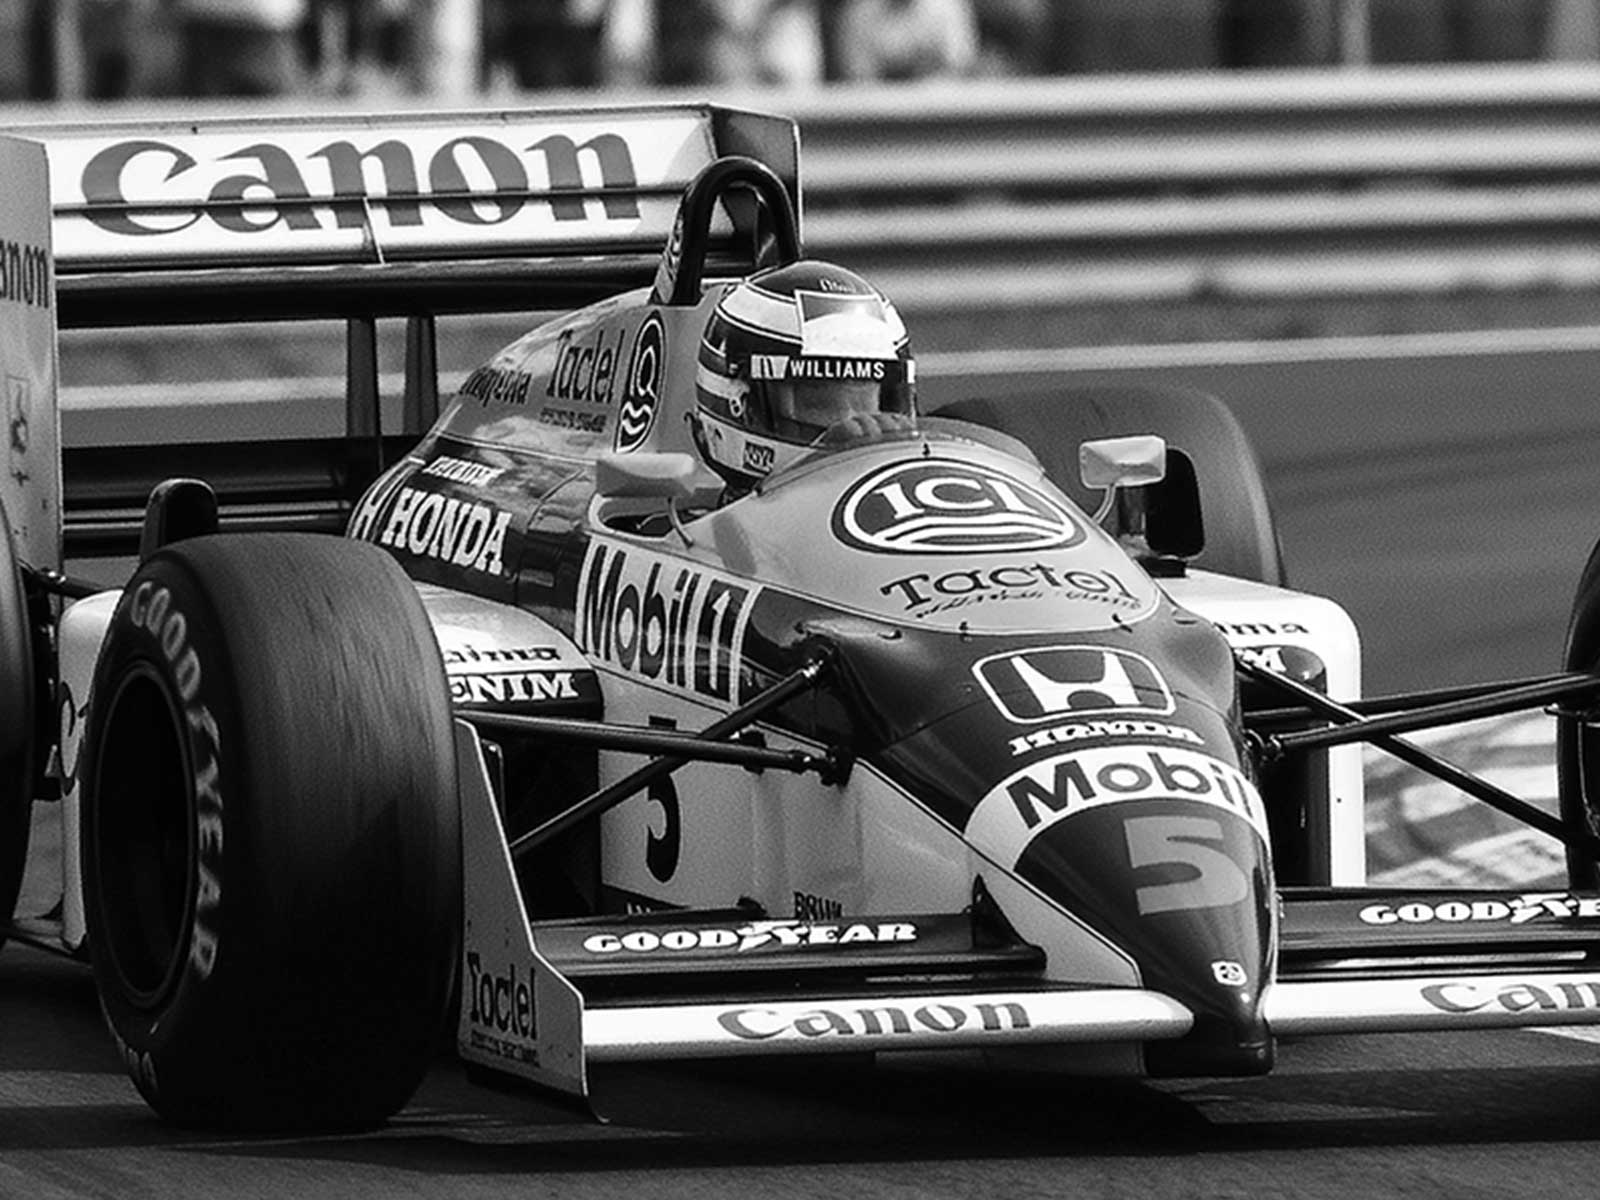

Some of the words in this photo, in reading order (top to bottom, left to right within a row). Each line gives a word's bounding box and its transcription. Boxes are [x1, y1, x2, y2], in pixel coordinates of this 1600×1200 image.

[81, 132, 642, 236] Canon
[790, 360, 886, 380] WILLIAMS
[873, 476, 1041, 520] ICI
[381, 487, 513, 576] HONDA
[880, 563, 1137, 611] Tactel
[583, 544, 701, 689] Mobil
[1008, 720, 1206, 757] HONDA
[1005, 751, 1254, 830] Mobil
[1122, 815, 1249, 917] 5
[583, 919, 918, 952] GOODYEAR
[717, 1002, 1032, 1041] Canon
